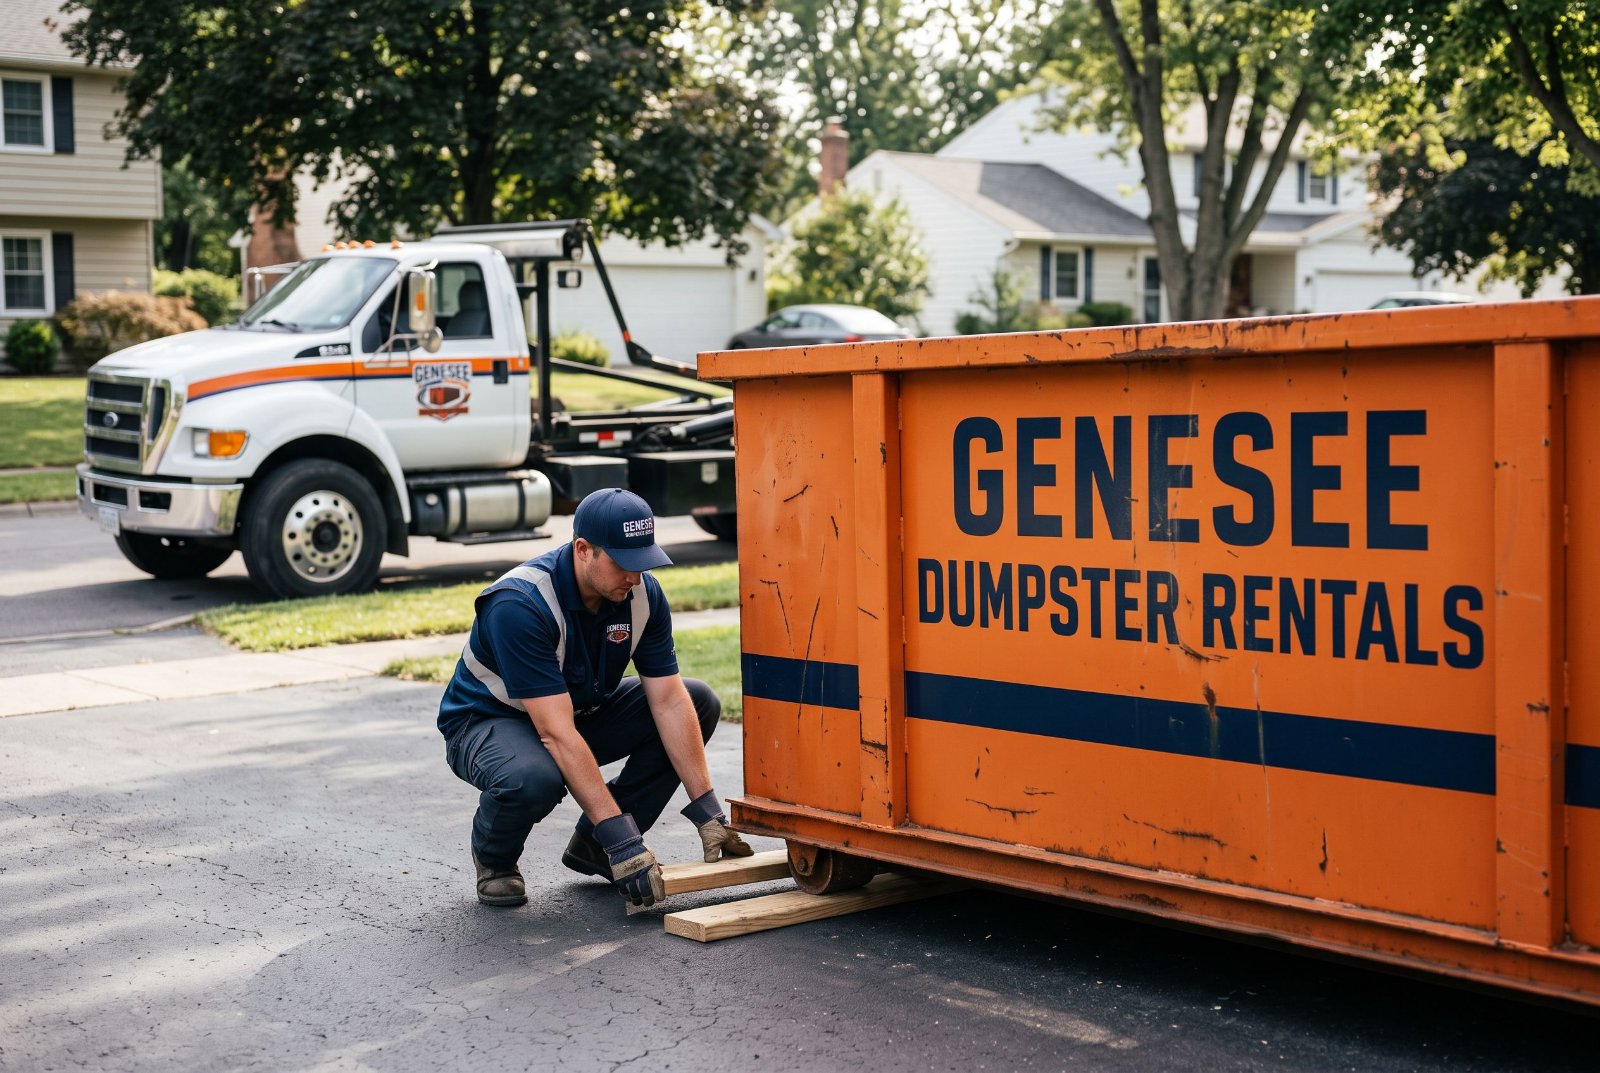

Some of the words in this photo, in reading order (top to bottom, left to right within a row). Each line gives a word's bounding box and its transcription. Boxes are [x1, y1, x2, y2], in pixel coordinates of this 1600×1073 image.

[952, 409, 1429, 551] GENESEE
[917, 558, 1180, 645] DUMPSTER
[1202, 572, 1484, 670] RENTALS
